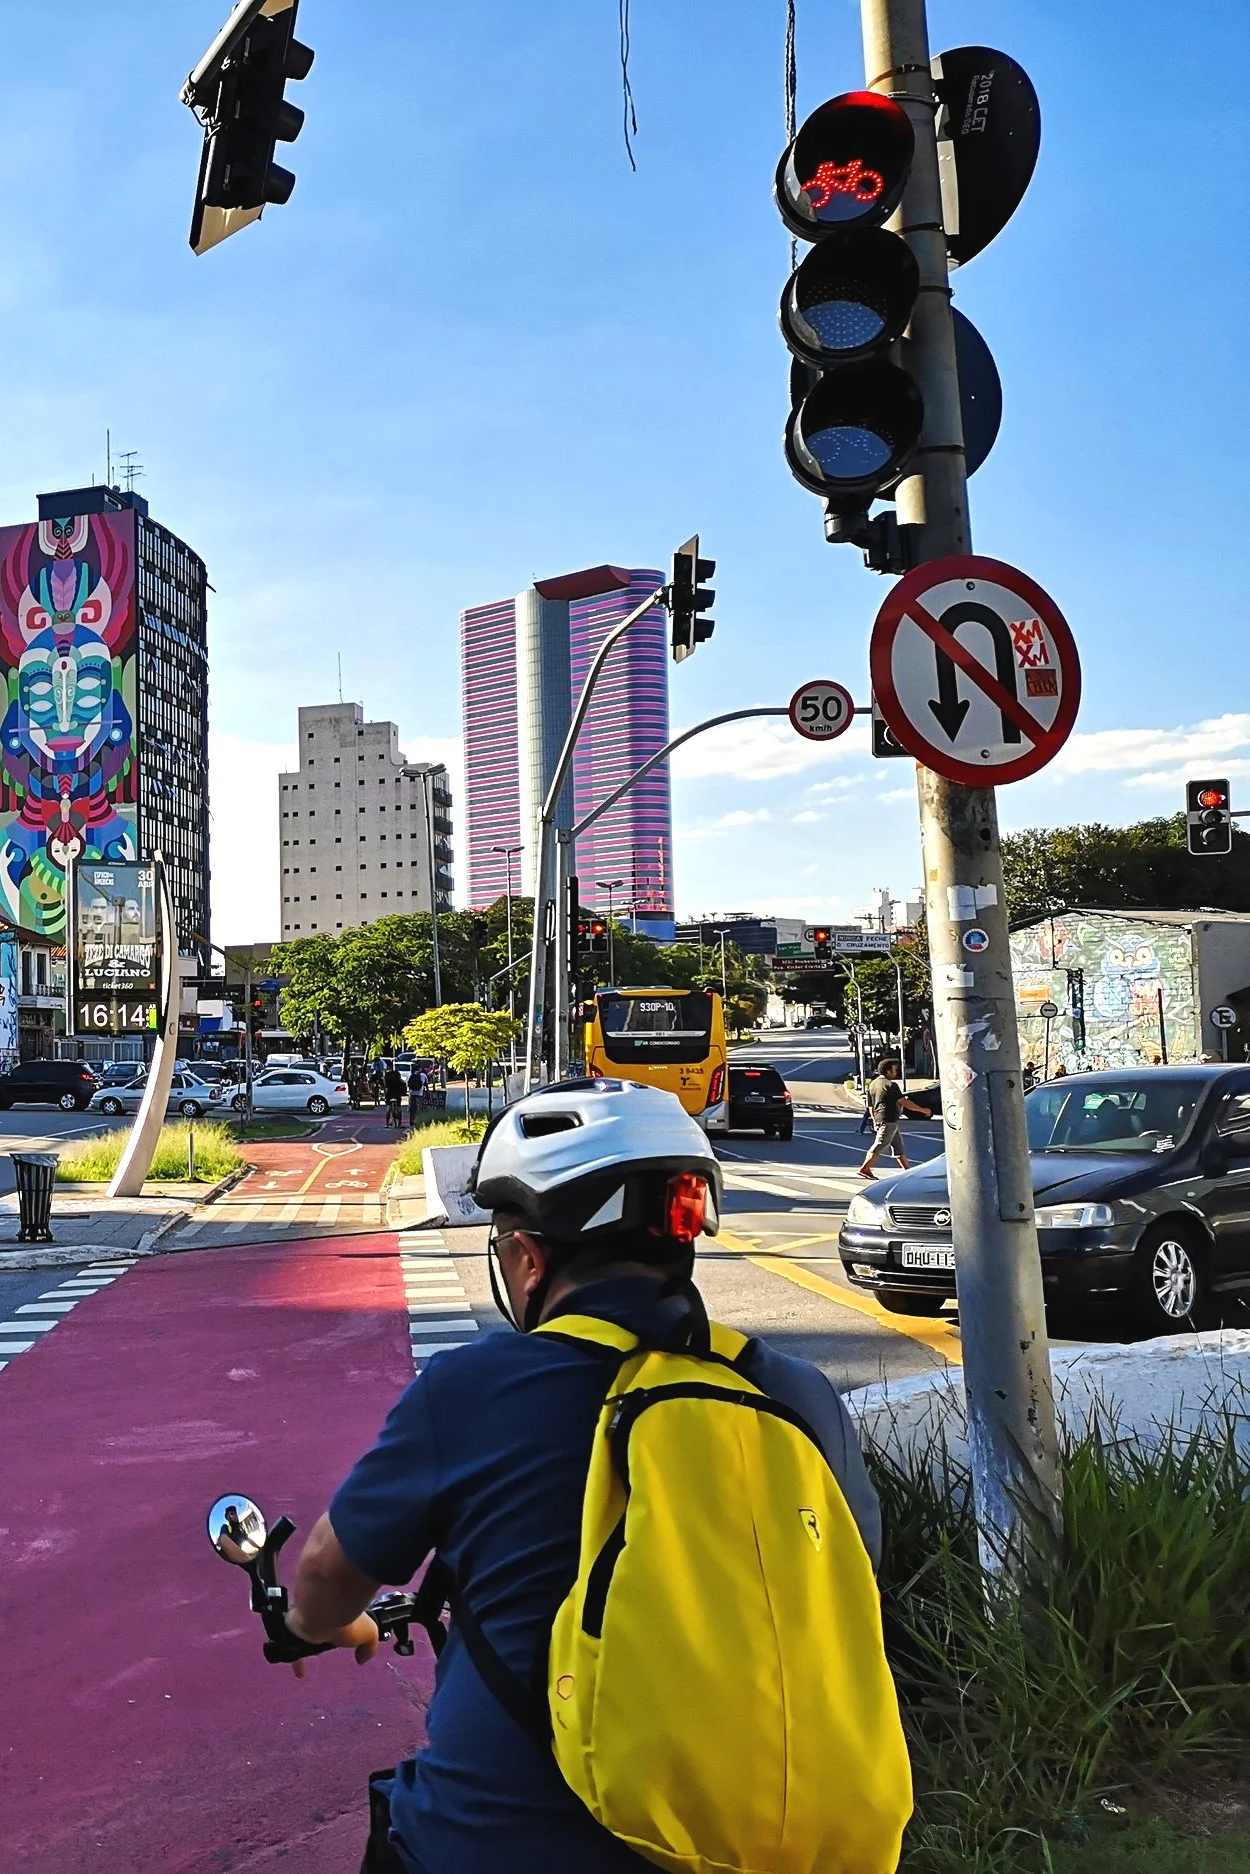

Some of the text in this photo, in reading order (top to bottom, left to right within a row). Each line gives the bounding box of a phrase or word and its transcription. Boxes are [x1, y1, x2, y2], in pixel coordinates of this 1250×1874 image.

[800, 695, 842, 722] 50
[809, 724, 833, 732] km/h
[137, 870, 154, 881] 30
[104, 943, 114, 959] DI
[114, 943, 150, 969] CAMARGO
[84, 968, 151, 977] LUCIANO
[639, 1002, 675, 1012] 930P-10
[80, 1003, 146, 1028] 16:14
